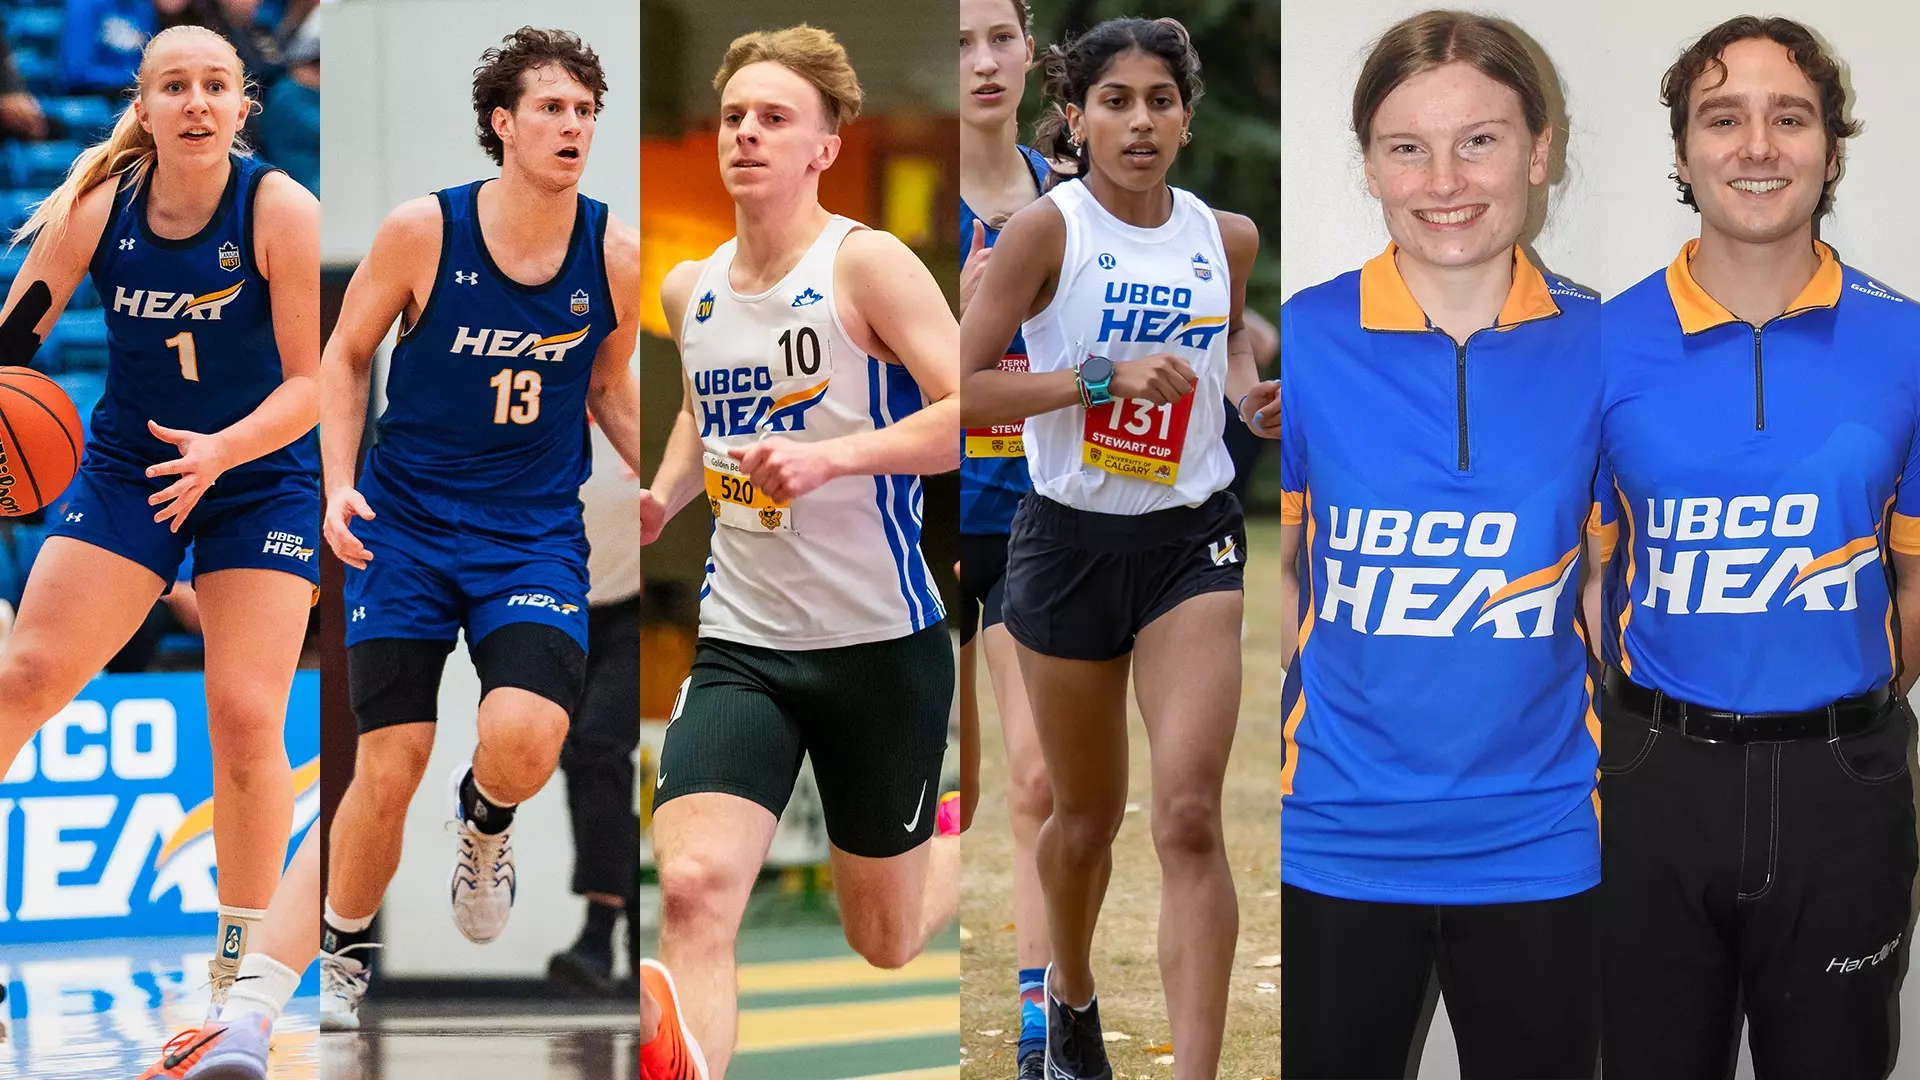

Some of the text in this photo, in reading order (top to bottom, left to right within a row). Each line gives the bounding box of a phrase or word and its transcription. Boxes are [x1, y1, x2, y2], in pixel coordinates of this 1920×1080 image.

[221, 257, 238, 267] WEST
[113, 279, 245, 320] HEAT
[1104, 281, 1192, 309] UBCO
[1546, 284, 1595, 300] oldline
[1850, 283, 1904, 303] Goldline
[450, 324, 591, 361] HEAT
[1096, 309, 1228, 350] HEAT
[165, 331, 199, 382] 1
[777, 326, 821, 377] 10
[490, 368, 541, 425] 13
[695, 366, 772, 395] UBCO
[700, 377, 831, 438] HEAT
[1108, 396, 1172, 440] 131
[1092, 432, 1171, 457] STEWART CUP
[1106, 454, 1142, 466] UNIVERSITY
[711, 458, 729, 470] Golden
[1104, 459, 1151, 476] CALGARY
[721, 475, 753, 504] 520
[1329, 505, 1517, 557] UBCO
[1647, 493, 1819, 541] UBCO
[262, 540, 314, 562] HEAT
[267, 531, 303, 545] UBCO
[1319, 543, 1582, 639] HEAT
[1640, 535, 1880, 615] HEAT
